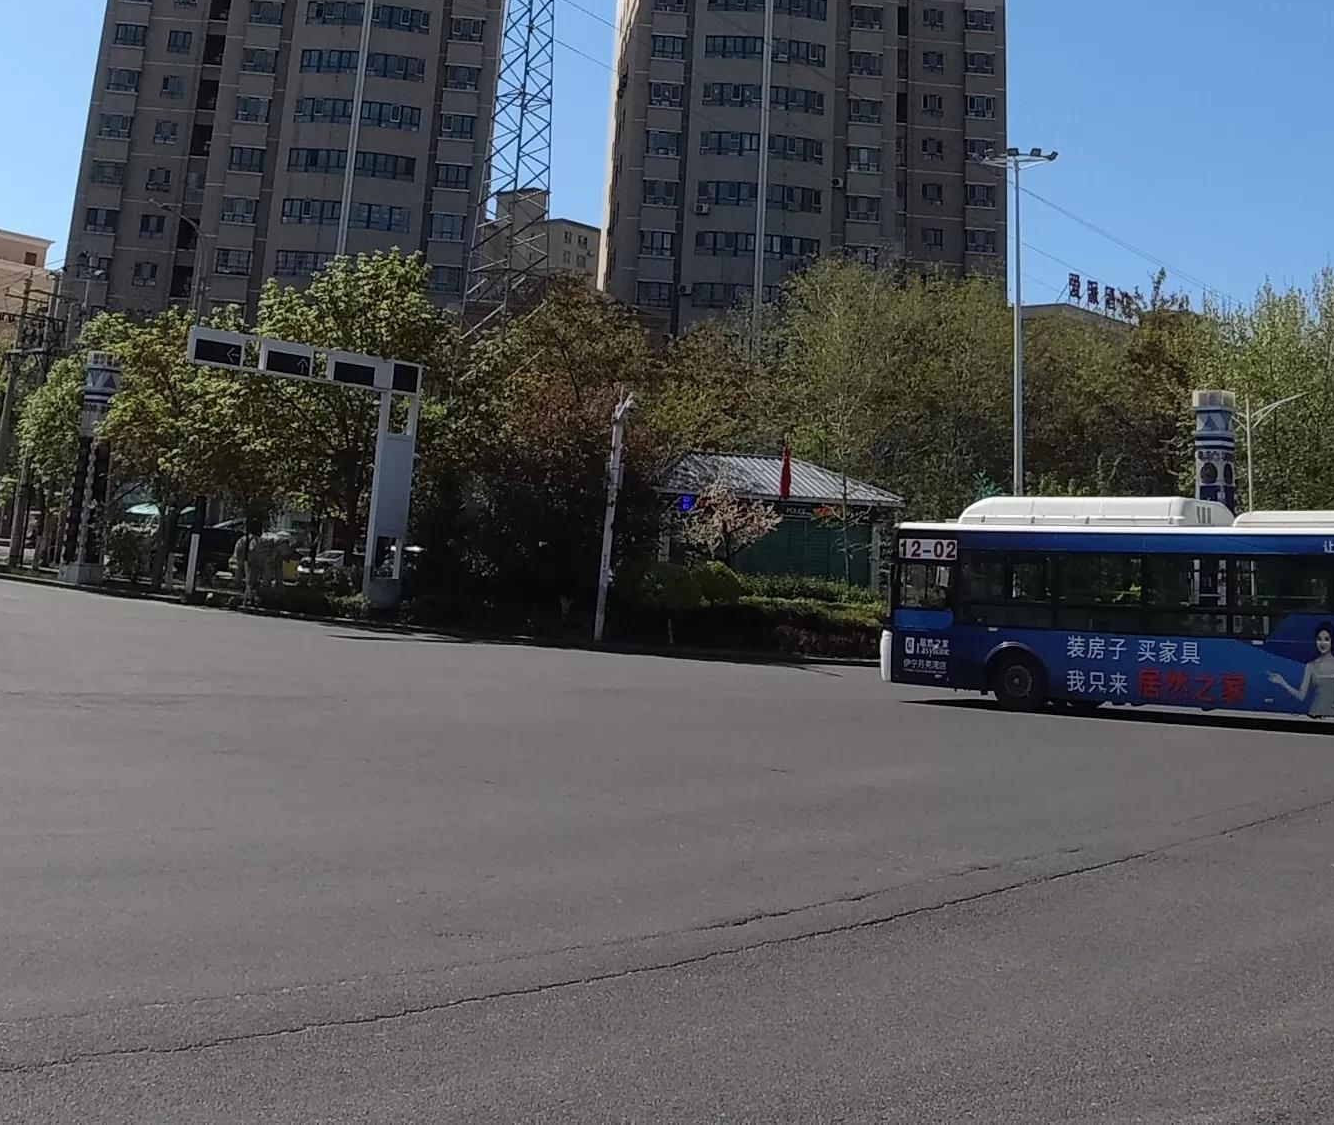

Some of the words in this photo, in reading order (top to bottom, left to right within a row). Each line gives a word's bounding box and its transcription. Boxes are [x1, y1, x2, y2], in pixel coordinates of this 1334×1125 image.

[900, 539, 957, 559] 12-02
[1066, 635, 1127, 660] 装房子
[1137, 639, 1201, 665] 买家具
[1066, 669, 1128, 695] 我只来
[1137, 667, 1247, 704] 居然之家
